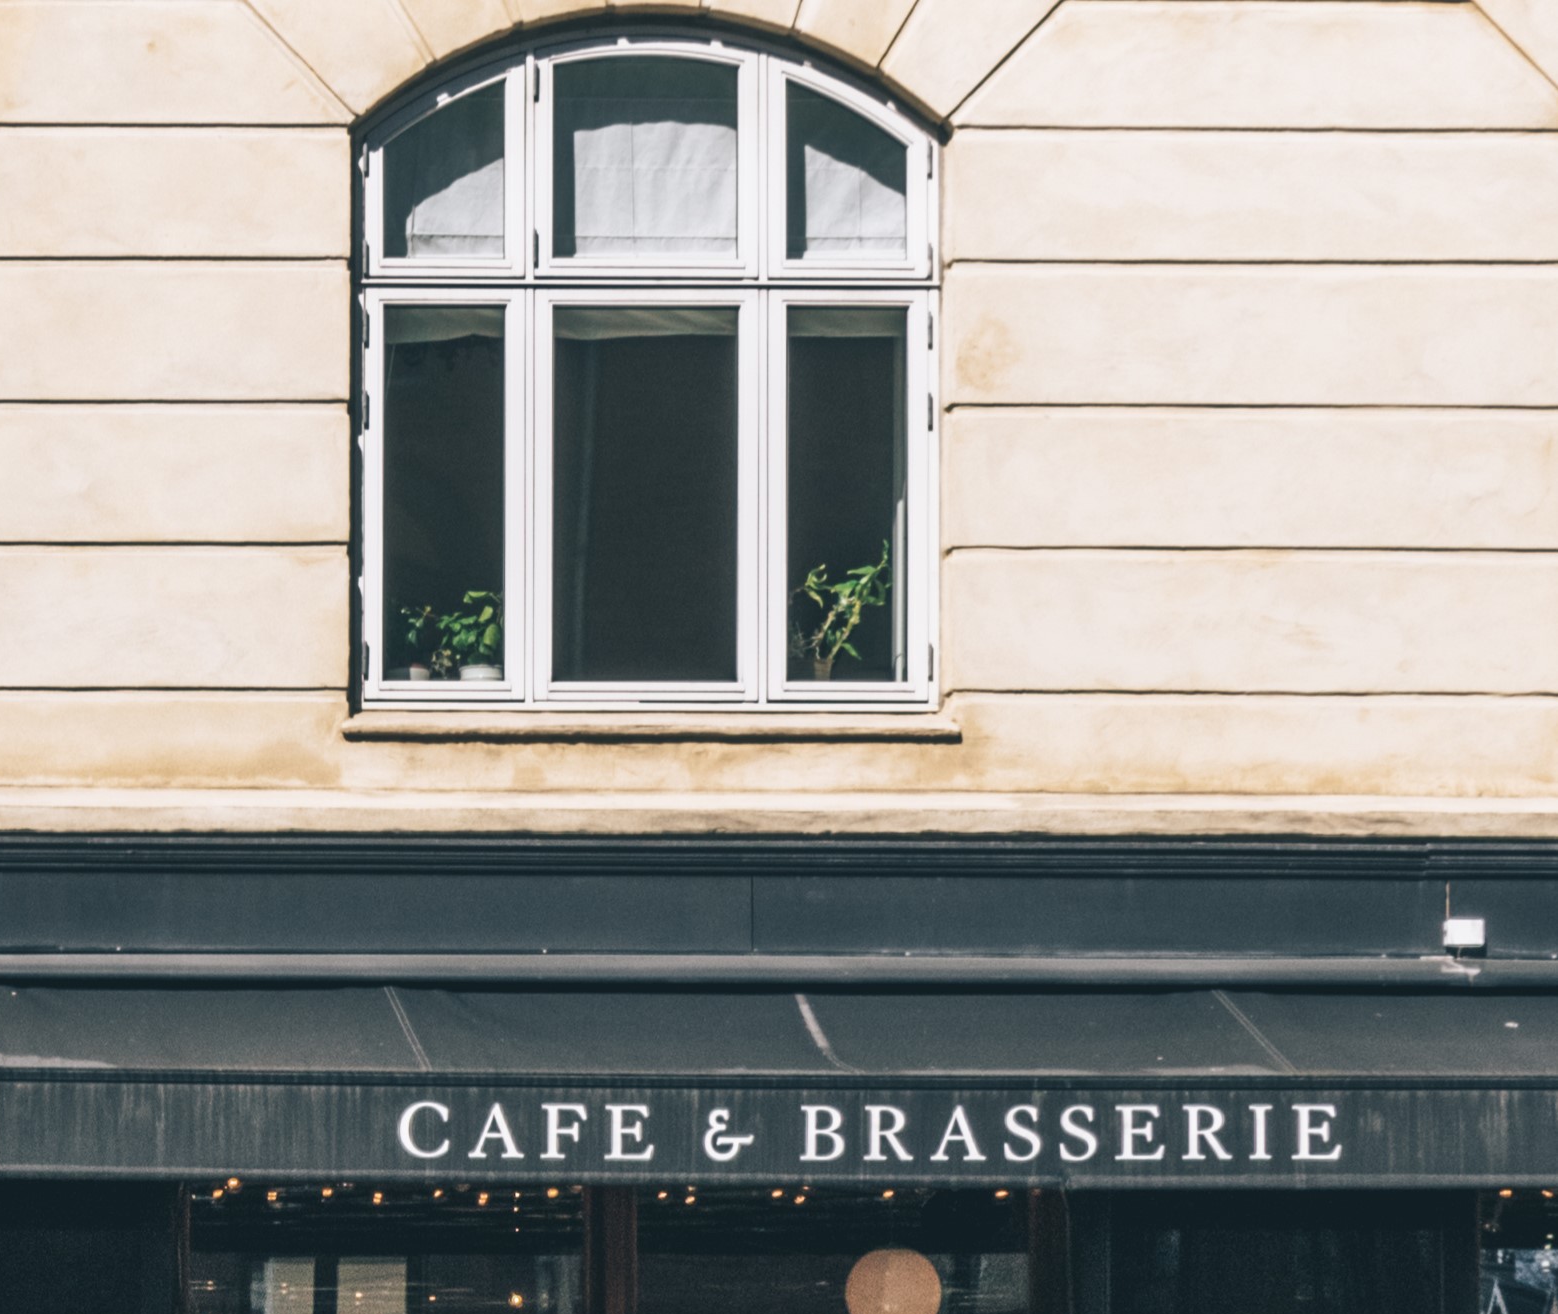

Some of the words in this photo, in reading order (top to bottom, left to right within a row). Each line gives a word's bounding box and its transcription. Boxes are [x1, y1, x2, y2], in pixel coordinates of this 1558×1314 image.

[398, 1101, 655, 1162] CAFE
[704, 1107, 754, 1162] &
[799, 1104, 1343, 1163] BRASSERIE
